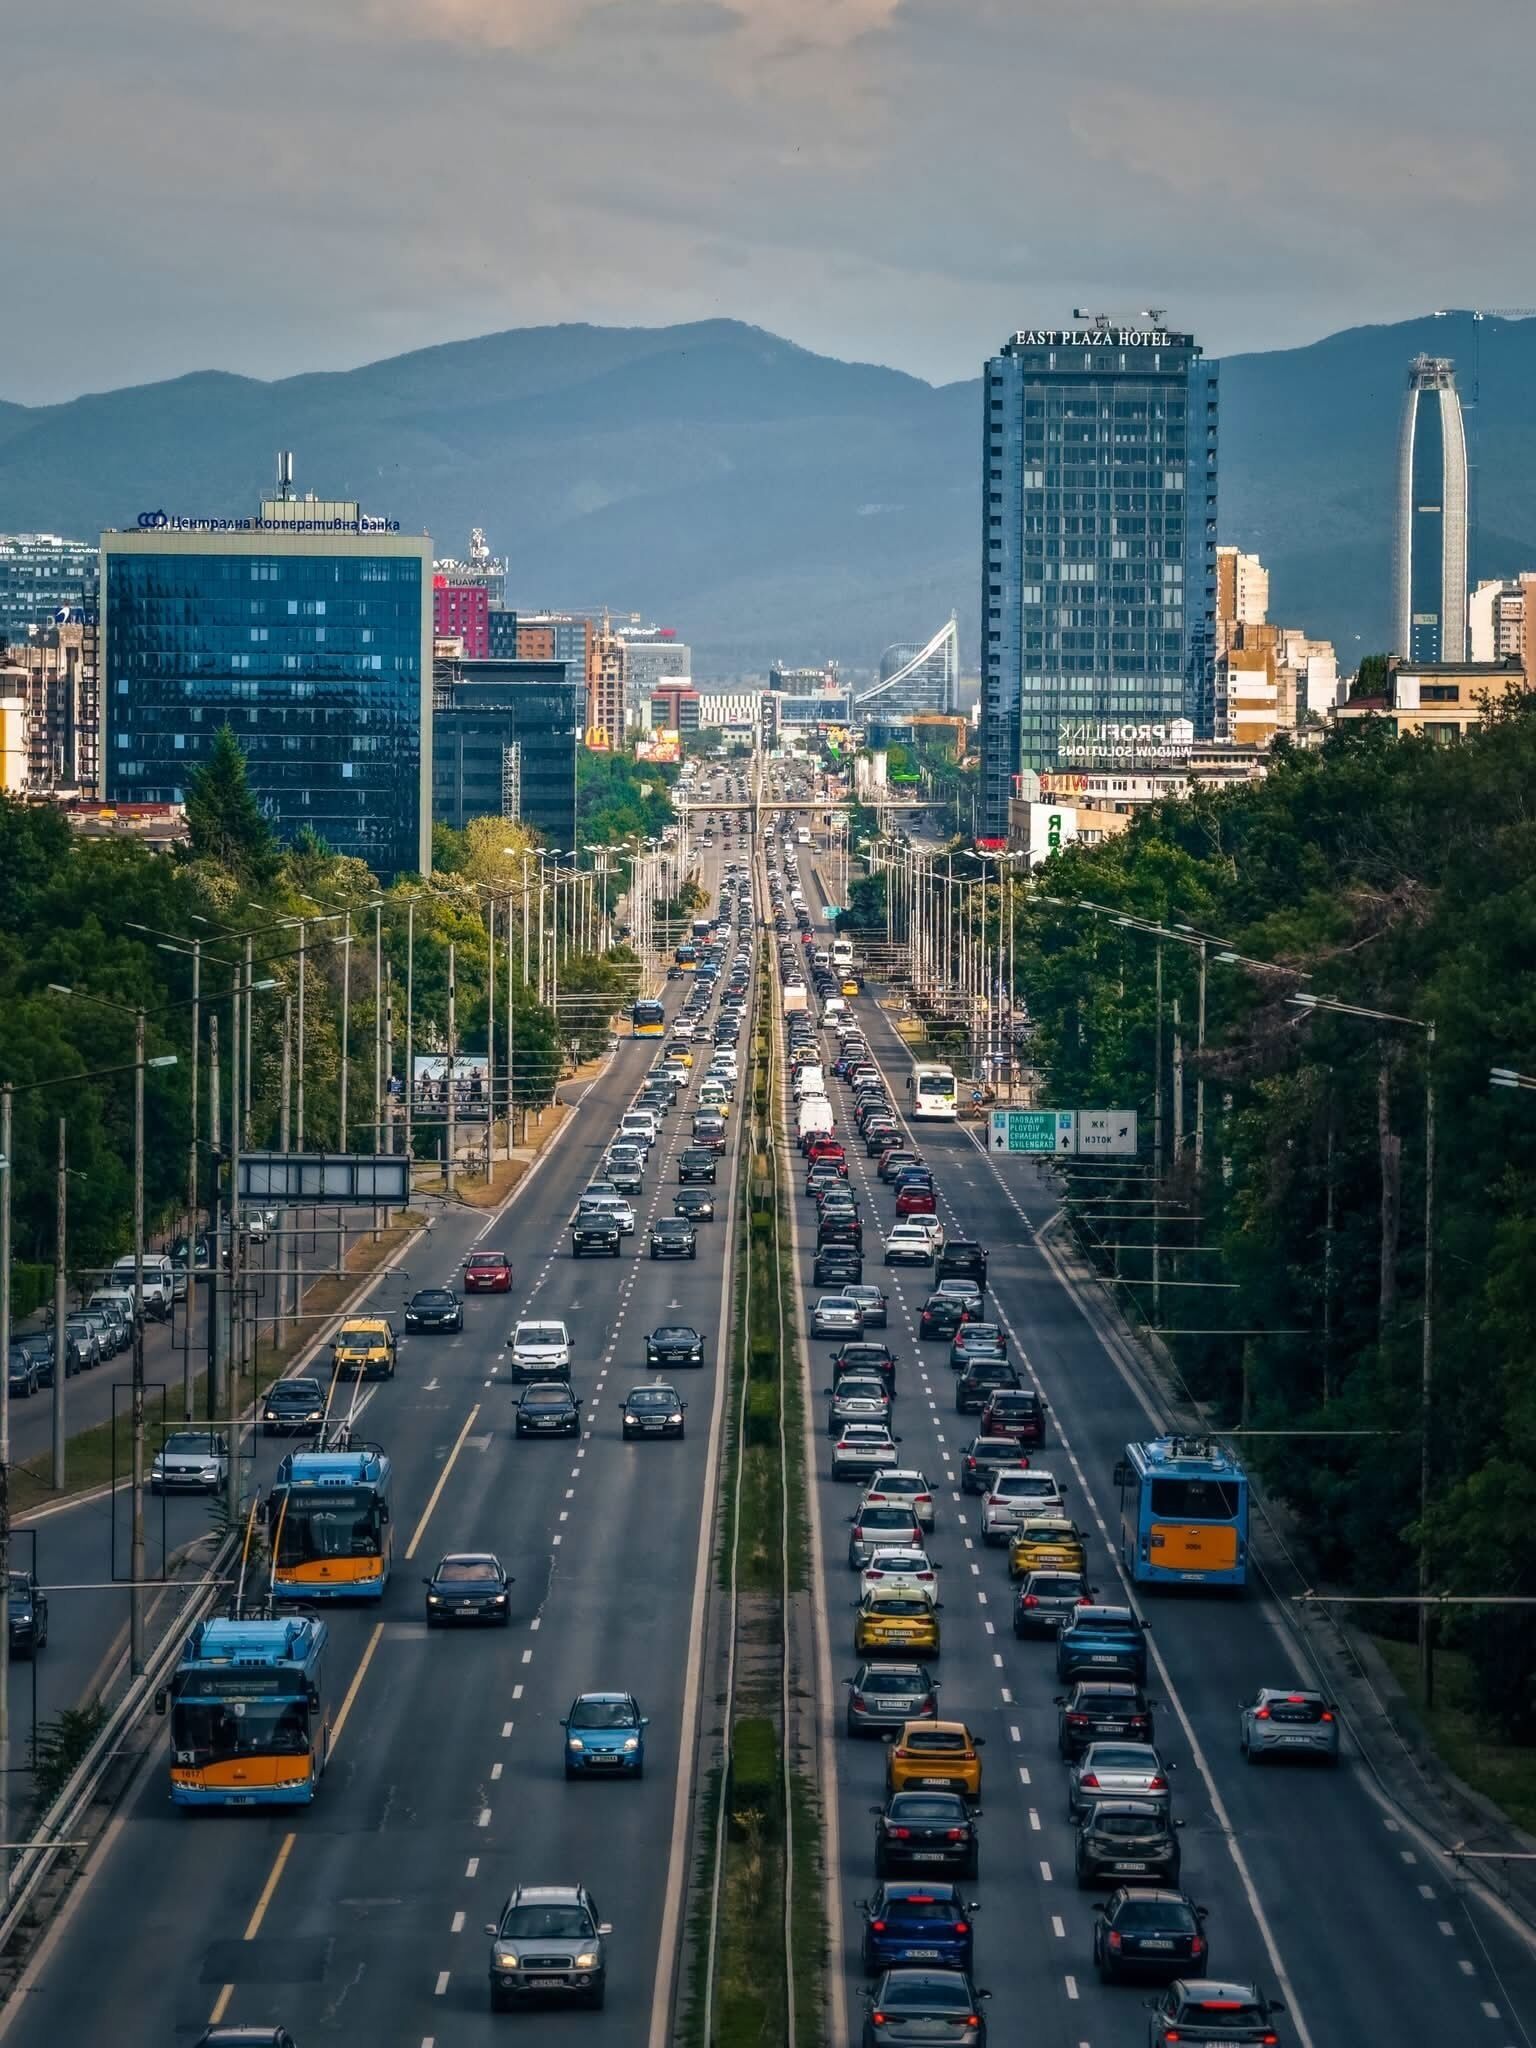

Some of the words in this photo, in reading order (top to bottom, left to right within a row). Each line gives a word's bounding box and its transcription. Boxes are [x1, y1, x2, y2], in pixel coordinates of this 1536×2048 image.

[1015, 330, 1056, 345] EAST
[1061, 331, 1114, 346] PLAZA
[1118, 331, 1171, 347] HOTEL
[171, 515, 250, 531] Централна
[255, 513, 359, 532] Кооперативна
[361, 516, 400, 531] Банка
[449, 578, 488, 586] HUAWEI
[1010, 1115, 1045, 1123] ПЛОВДИВ
[1091, 1120, 1105, 1128] ЖК
[1010, 1140, 1054, 1148] SVILENGRAD
[1085, 1136, 1112, 1144] ИЗТОК
